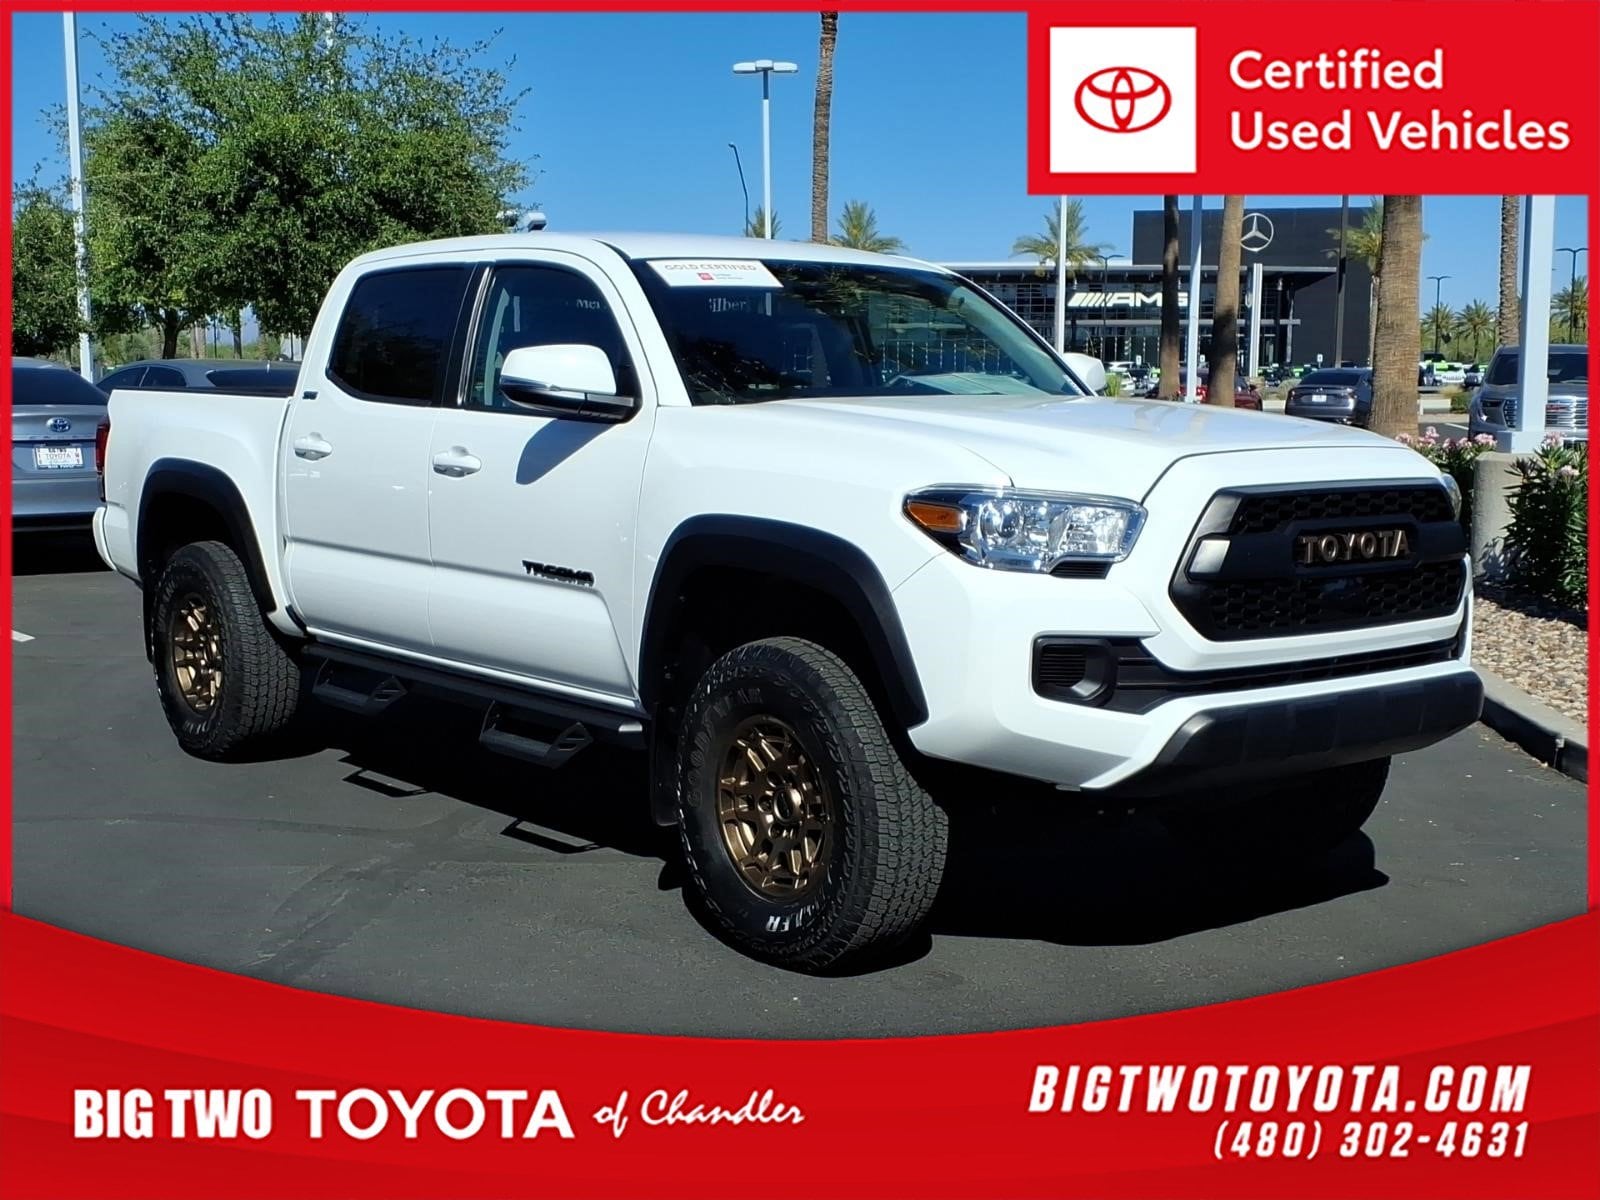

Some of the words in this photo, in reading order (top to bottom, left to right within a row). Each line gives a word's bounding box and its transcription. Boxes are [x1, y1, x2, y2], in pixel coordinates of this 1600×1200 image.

[664, 263, 699, 271] GOLD
[700, 263, 757, 271] CERTIFIED
[1299, 529, 1410, 564] TOYOTA
[522, 559, 595, 587] TACOMA
